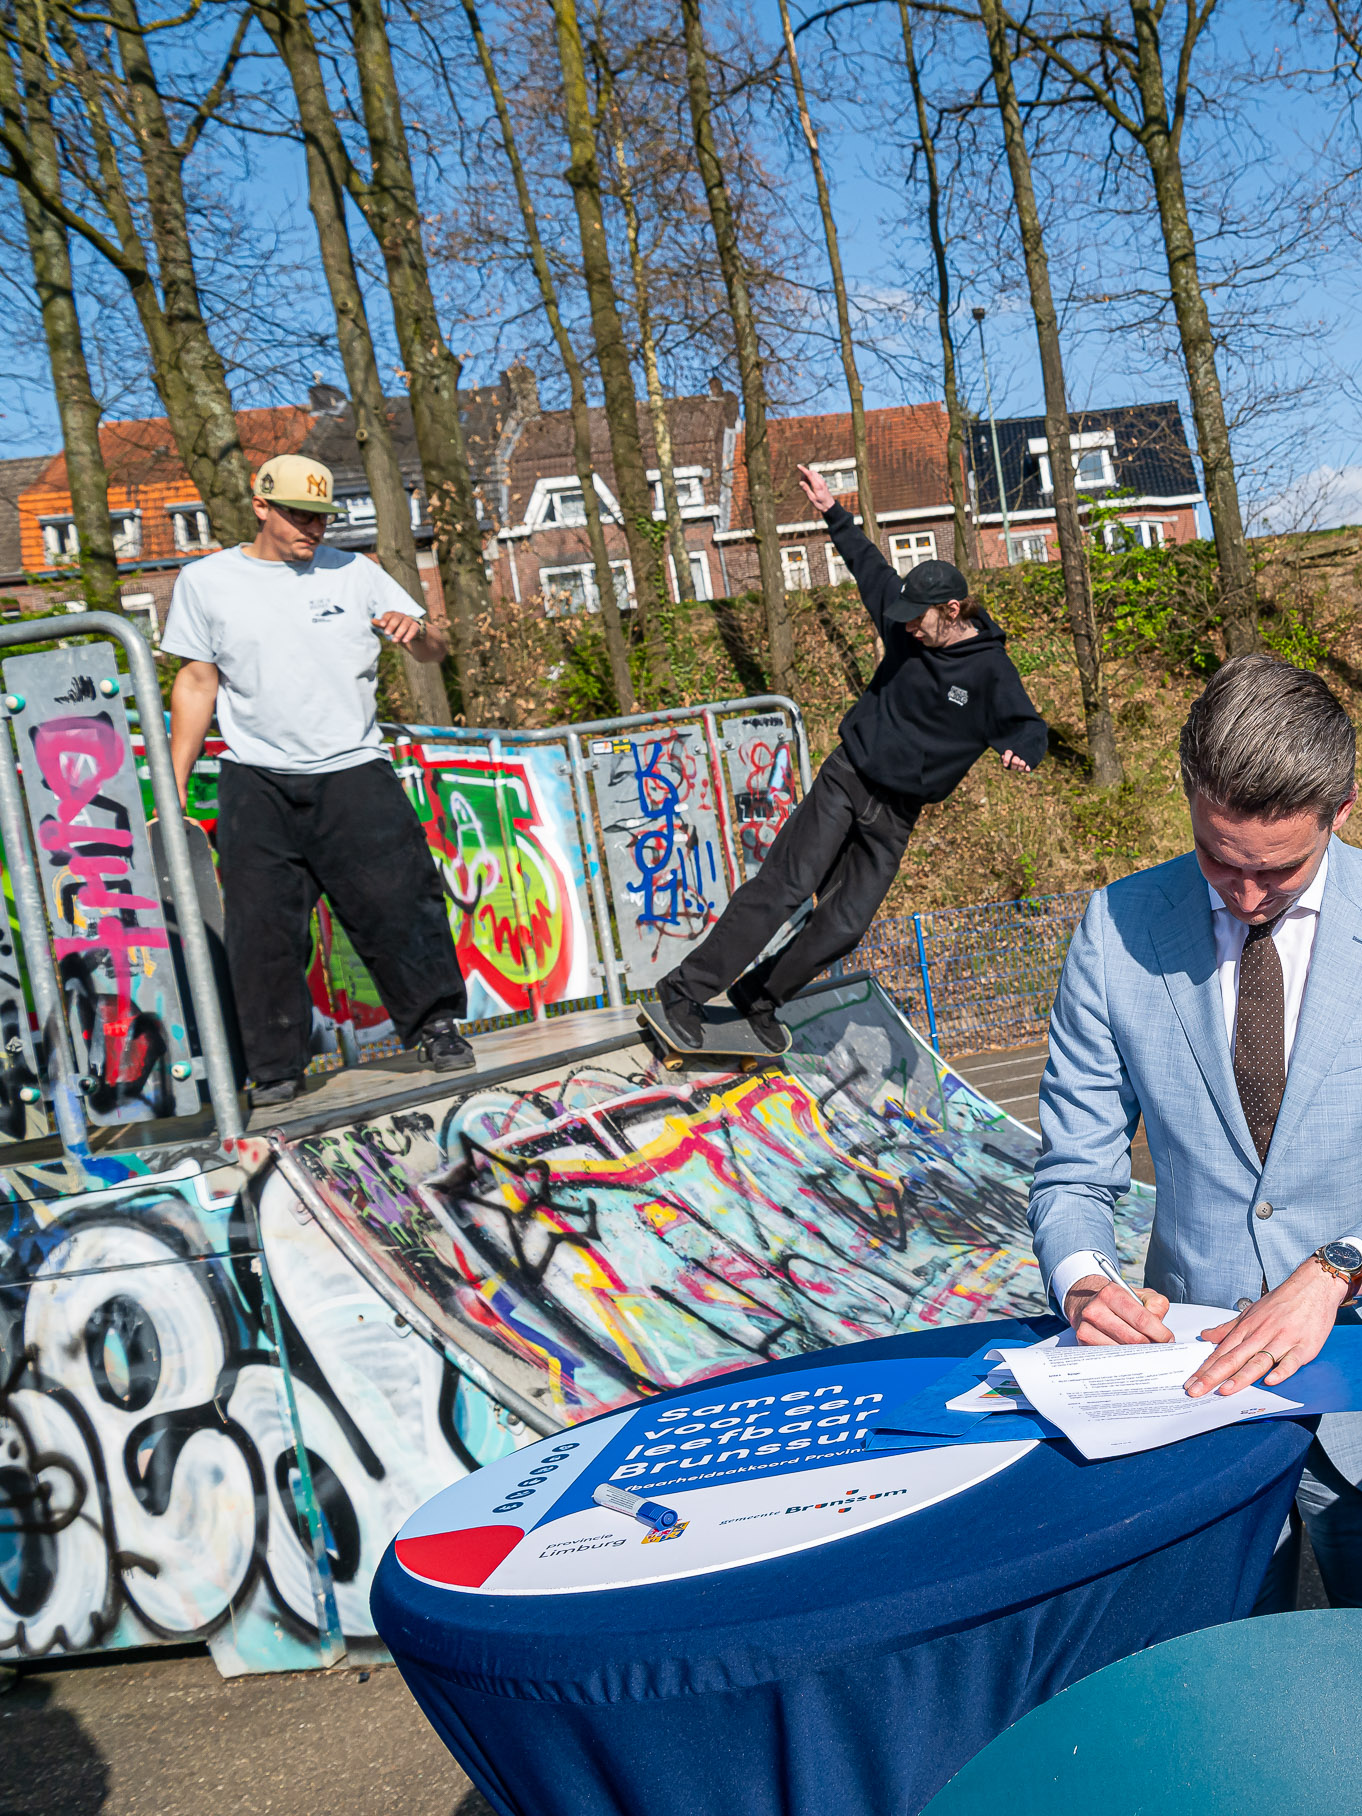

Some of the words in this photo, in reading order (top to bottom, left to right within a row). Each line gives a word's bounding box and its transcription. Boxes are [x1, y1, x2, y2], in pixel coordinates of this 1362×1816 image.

[643, 1411, 771, 1440] voor
[784, 1393, 884, 1416] een
[657, 1384, 843, 1423] Samen
[625, 1408, 881, 1460] leefbaar
[624, 1456, 801, 1492] fbaarheidsakkoord
[718, 1510, 781, 1526] gemeente
[538, 1538, 627, 1559] Limburg
[546, 1533, 614, 1550] provincie
